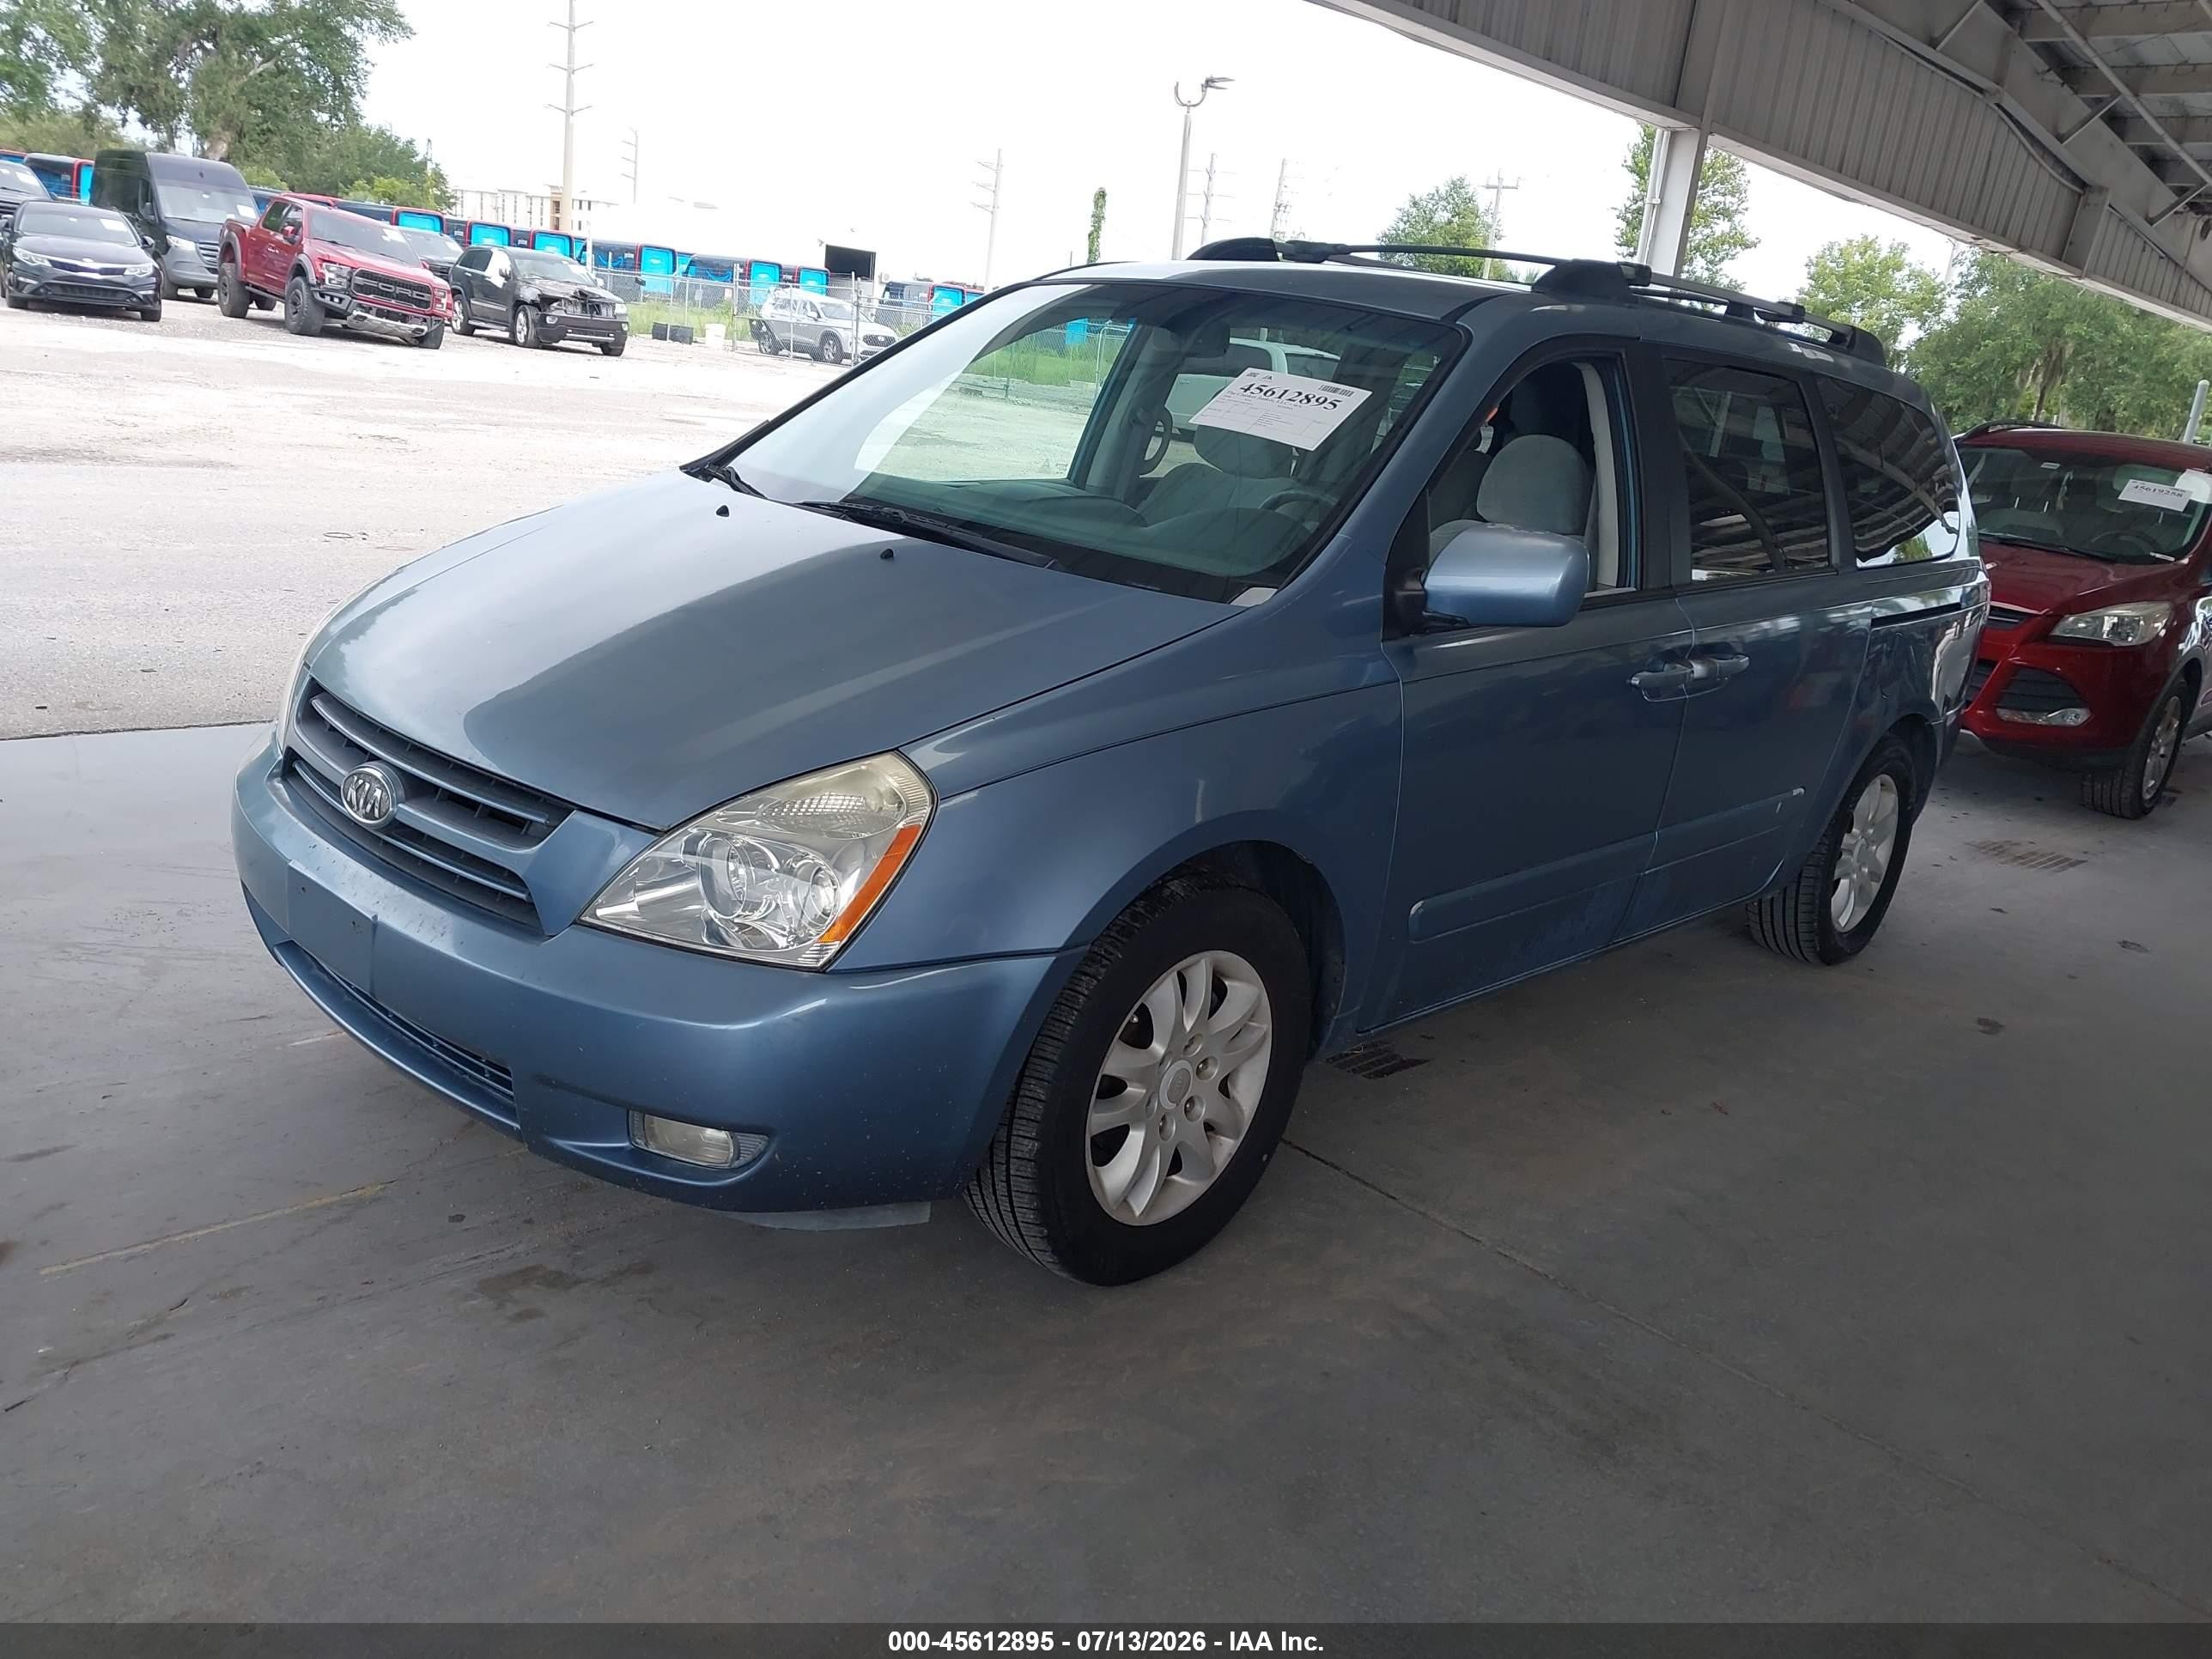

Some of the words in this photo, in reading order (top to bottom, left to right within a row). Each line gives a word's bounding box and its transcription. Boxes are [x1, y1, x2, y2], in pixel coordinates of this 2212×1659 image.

[356, 276, 429, 301] FORD
[1239, 382, 1344, 410] 45612895
[346, 775, 383, 818] KIA
